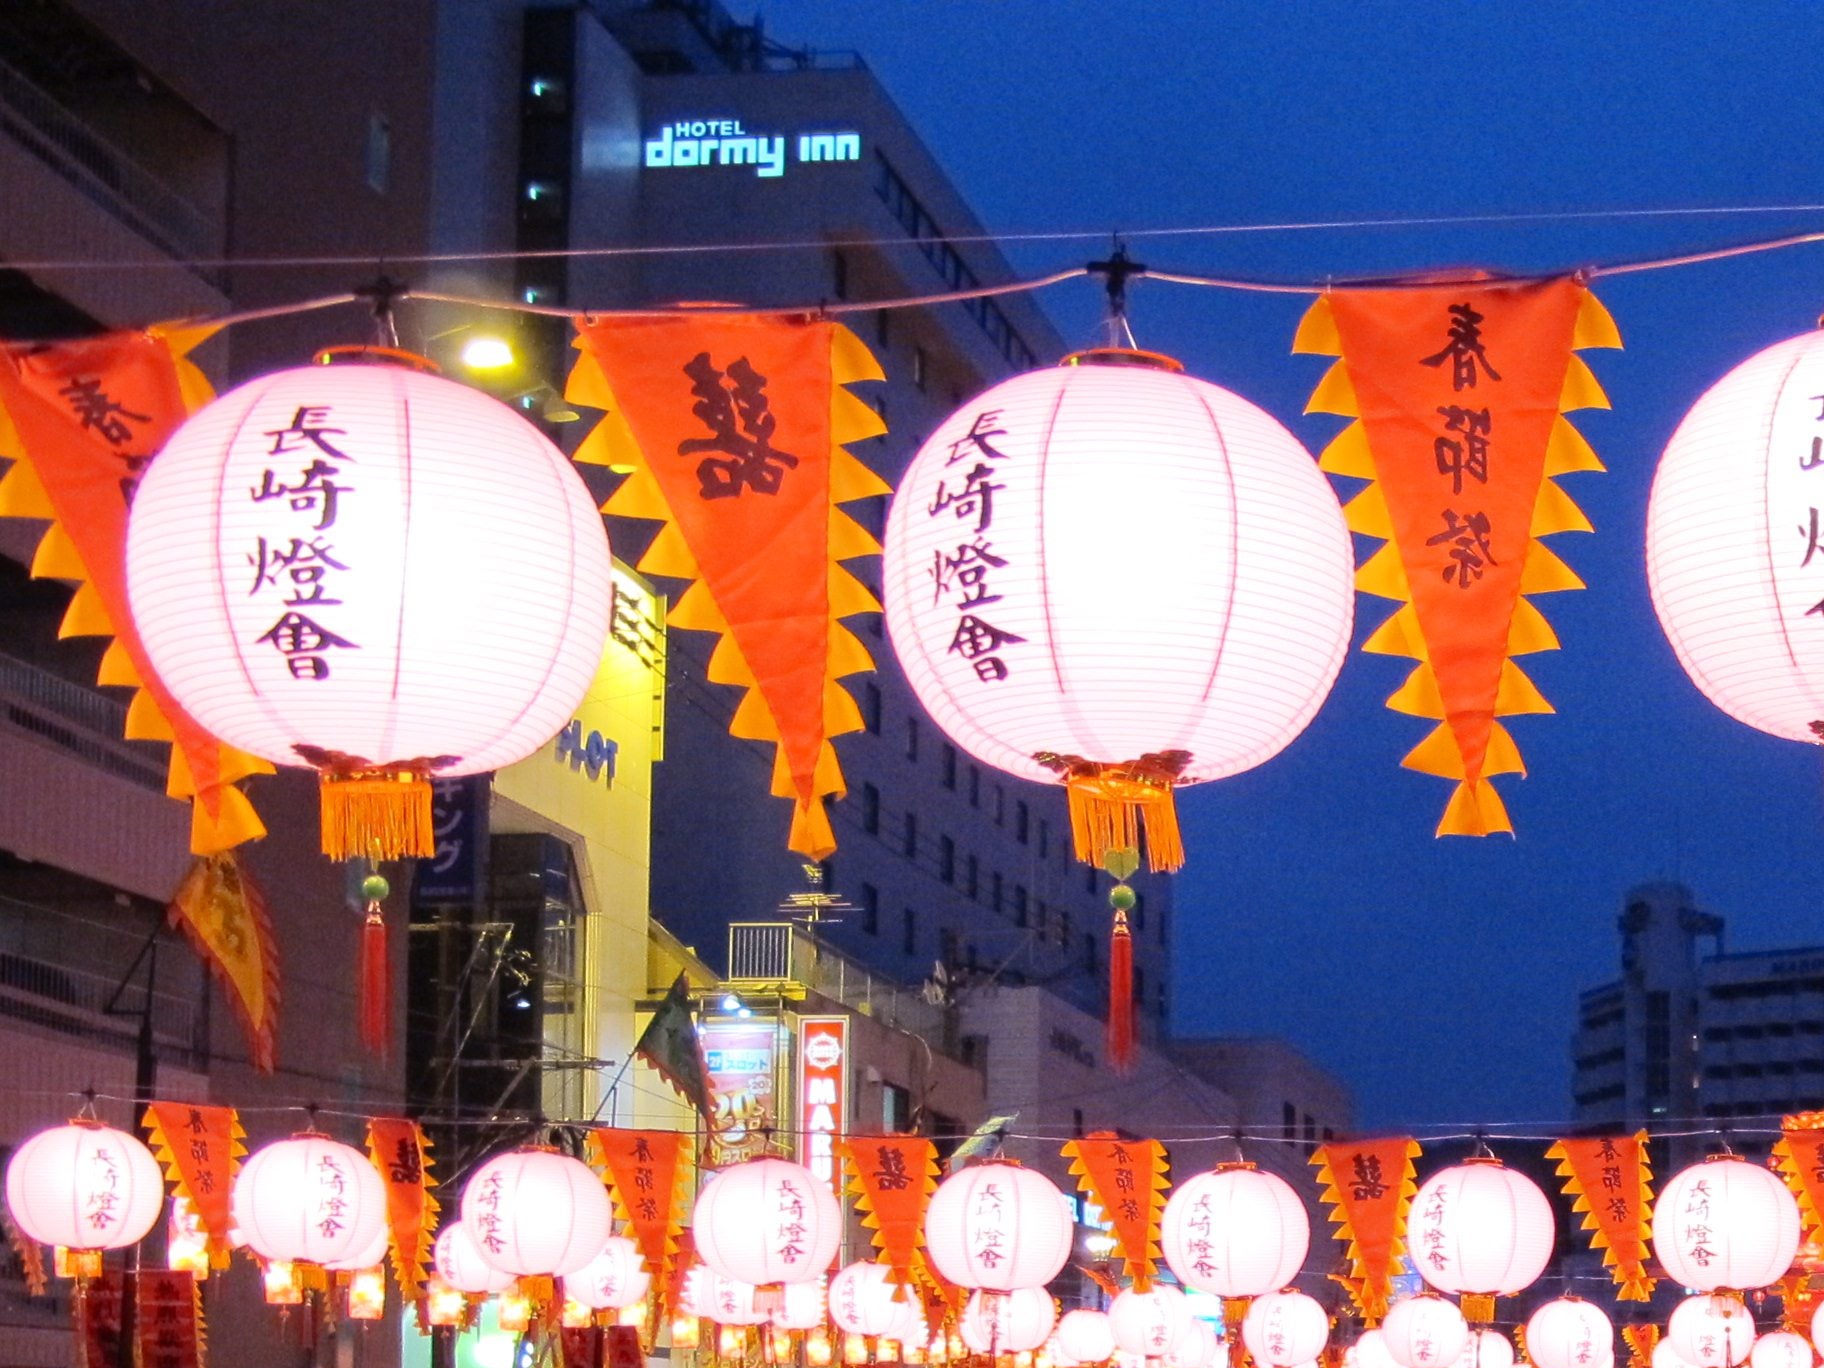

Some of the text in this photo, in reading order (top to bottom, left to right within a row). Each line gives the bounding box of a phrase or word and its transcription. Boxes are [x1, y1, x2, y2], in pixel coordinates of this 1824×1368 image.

[646, 126, 860, 177] dormy inn
[675, 120, 746, 137] HOTEL
[245, 404, 363, 682] 長崎燈會
[926, 407, 1028, 684] 長崎燈會
